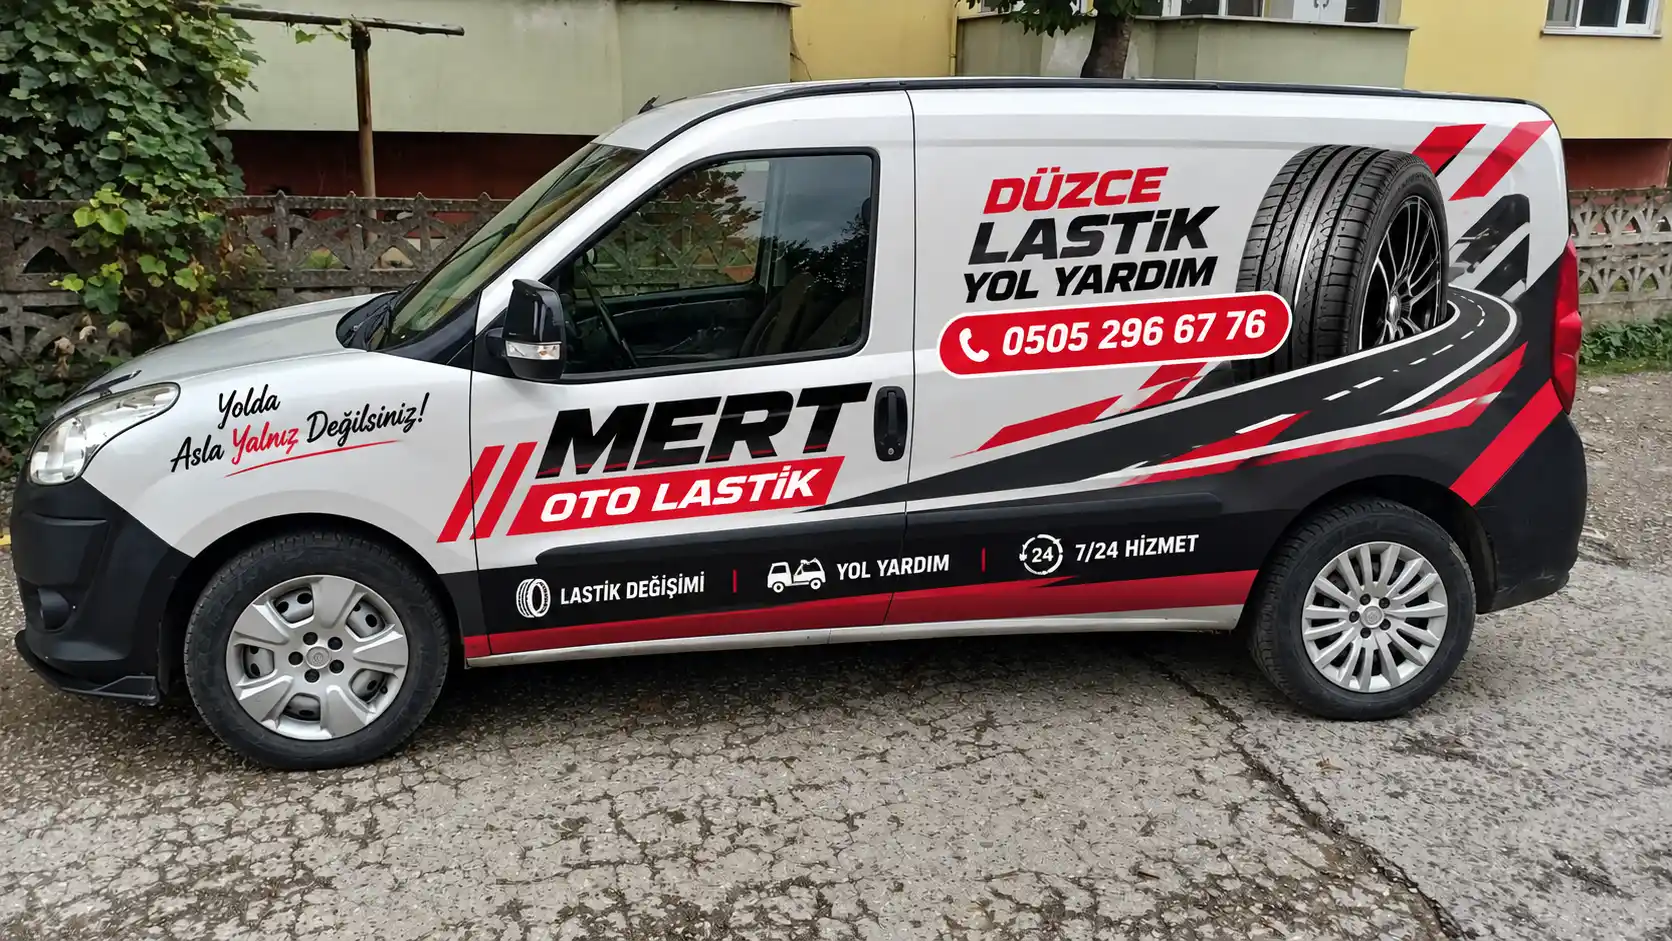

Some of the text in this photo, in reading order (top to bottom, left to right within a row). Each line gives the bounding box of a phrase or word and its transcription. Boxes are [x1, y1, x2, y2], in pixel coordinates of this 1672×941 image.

[982, 166, 1169, 215] DÜZCE
[963, 256, 1219, 304] YOL YARDIM
[1002, 309, 1267, 356] 0505 296 67 76
[217, 383, 281, 430] Yolda
[170, 392, 430, 473] Asla Yalnız Değilsiniz!
[535, 382, 873, 480] MERT
[540, 486, 640, 523] OTO
[836, 553, 951, 582] YOL YARDIM
[1031, 546, 1054, 563] 24
[1075, 534, 1200, 563] 7/24 HİZMET
[560, 571, 706, 606] LASTİK DEĞİŞİMİ
